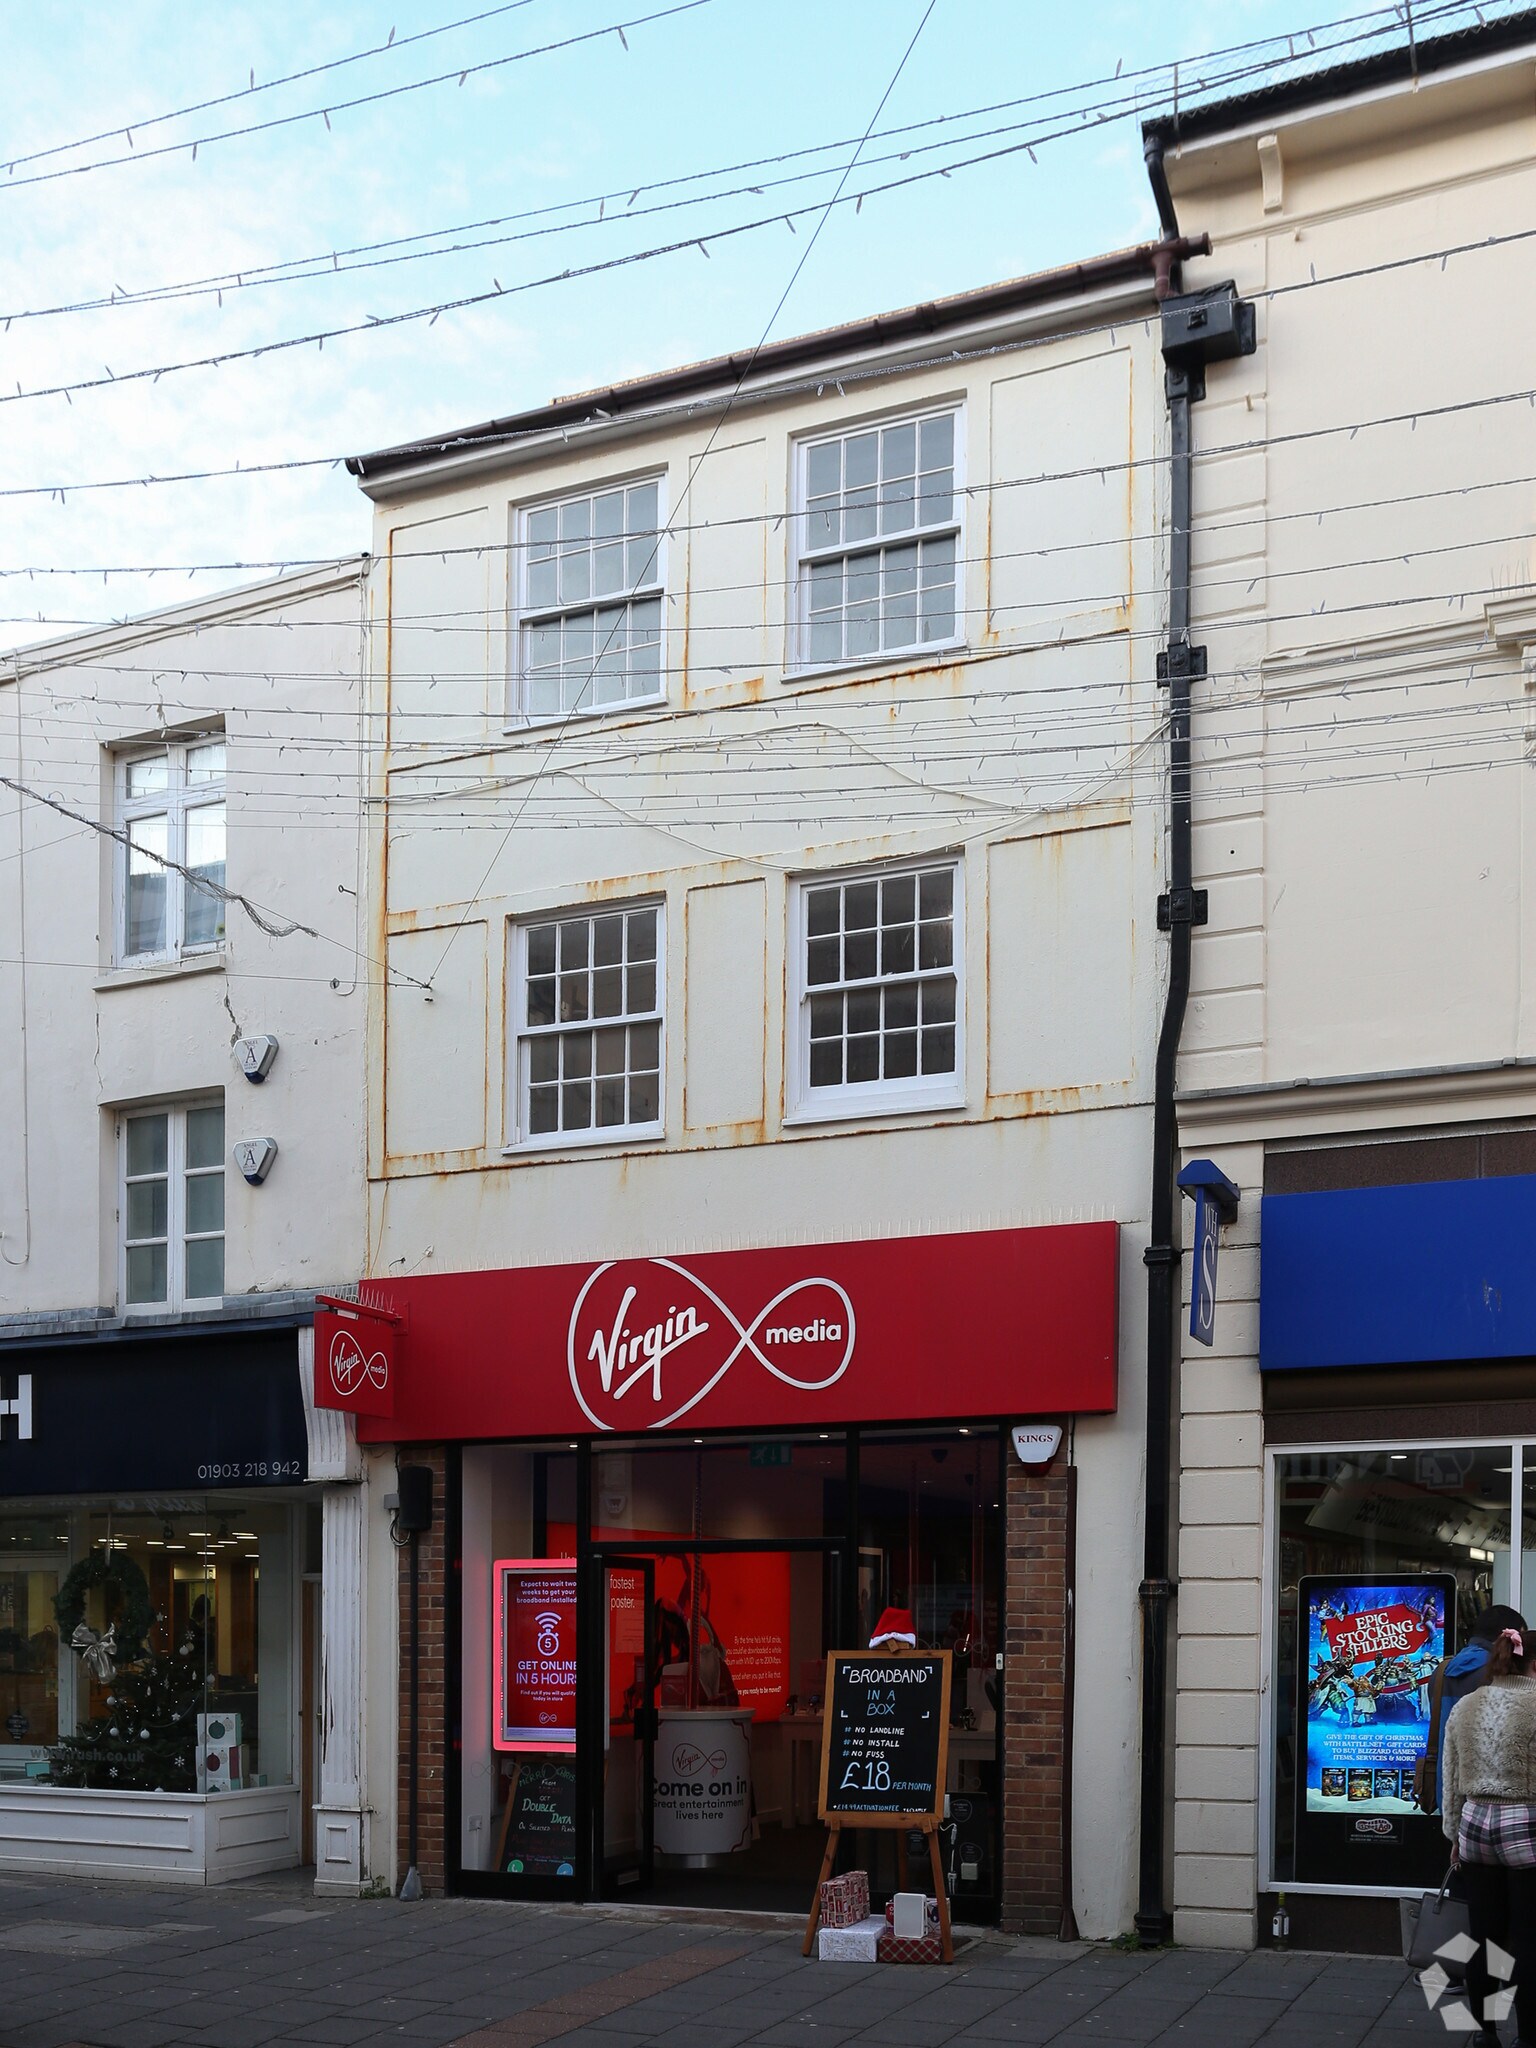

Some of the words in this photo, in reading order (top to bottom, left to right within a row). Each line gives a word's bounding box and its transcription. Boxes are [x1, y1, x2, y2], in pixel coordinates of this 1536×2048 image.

[766, 1319, 842, 1345] media
[588, 1286, 710, 1402] Virgin
[334, 1342, 360, 1385] Virgin
[370, 1366, 386, 1375] media
[1018, 1434, 1053, 1443] KINGS
[198, 1464, 240, 1479] 01903
[245, 1462, 268, 1477] 218
[272, 1461, 300, 1476] 942
[520, 1580, 541, 1588] Expect
[610, 1574, 635, 1590] fastest
[611, 1596, 635, 1612] poster.
[1355, 1612, 1389, 1630] EPIC
[544, 1638, 552, 1648] 5
[1333, 1619, 1414, 1653] STOCKING
[1346, 1633, 1411, 1658] FILLERS
[518, 1661, 538, 1670] GET
[516, 1673, 528, 1684] IN
[531, 1673, 538, 1684] 5
[848, 1668, 928, 1684] BROADBAND
[867, 1690, 880, 1700] IN
[887, 1690, 896, 1701] A
[866, 1703, 896, 1717] BOX
[854, 1726, 866, 1734] NO
[870, 1726, 905, 1736] LANDLINE
[868, 1740, 900, 1748] INSTALL
[851, 1750, 863, 1758] NO
[866, 1751, 885, 1759] FUSS
[1392, 1748, 1418, 1756] GAMES,
[676, 1749, 701, 1771] Virgin
[840, 1761, 891, 1792] £18
[892, 1781, 907, 1790] PER
[907, 1782, 932, 1792] MONTH
[709, 1782, 732, 1796] on
[736, 1776, 747, 1794] in
[521, 1798, 556, 1812] DOUBLE
[680, 1798, 744, 1809] entertainment
[550, 1812, 572, 1824] DATA
[676, 1810, 699, 1820] lives
[702, 1810, 723, 1820] here
